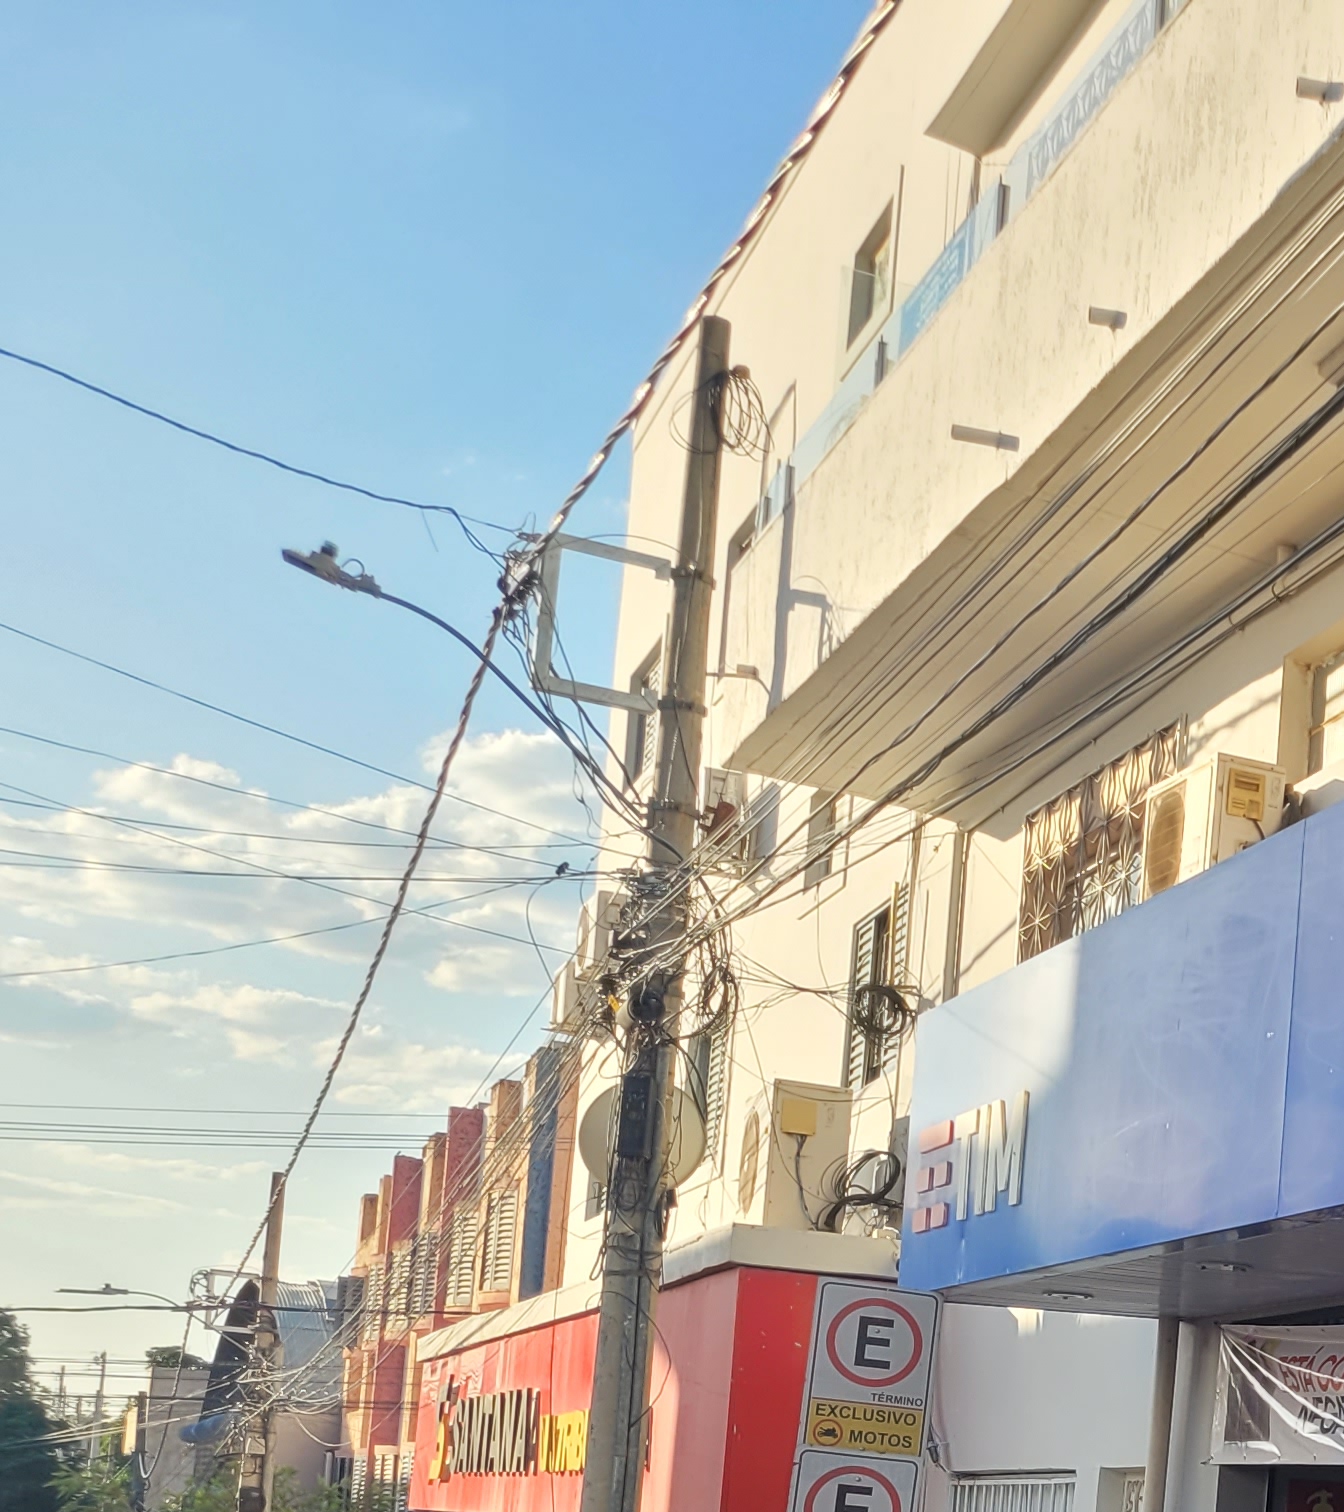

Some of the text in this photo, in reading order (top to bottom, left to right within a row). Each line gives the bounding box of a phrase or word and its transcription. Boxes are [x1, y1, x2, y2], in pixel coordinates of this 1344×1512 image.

[955, 1089, 1030, 1221] TIM
[854, 1315, 895, 1370] E
[1278, 1346, 1325, 1393] ESTÁ
[815, 1403, 917, 1426] EXCLUSIVO
[871, 1391, 924, 1407] TÉRMINO
[450, 1390, 540, 1473] SANTANA
[848, 1429, 913, 1448] MOTOS
